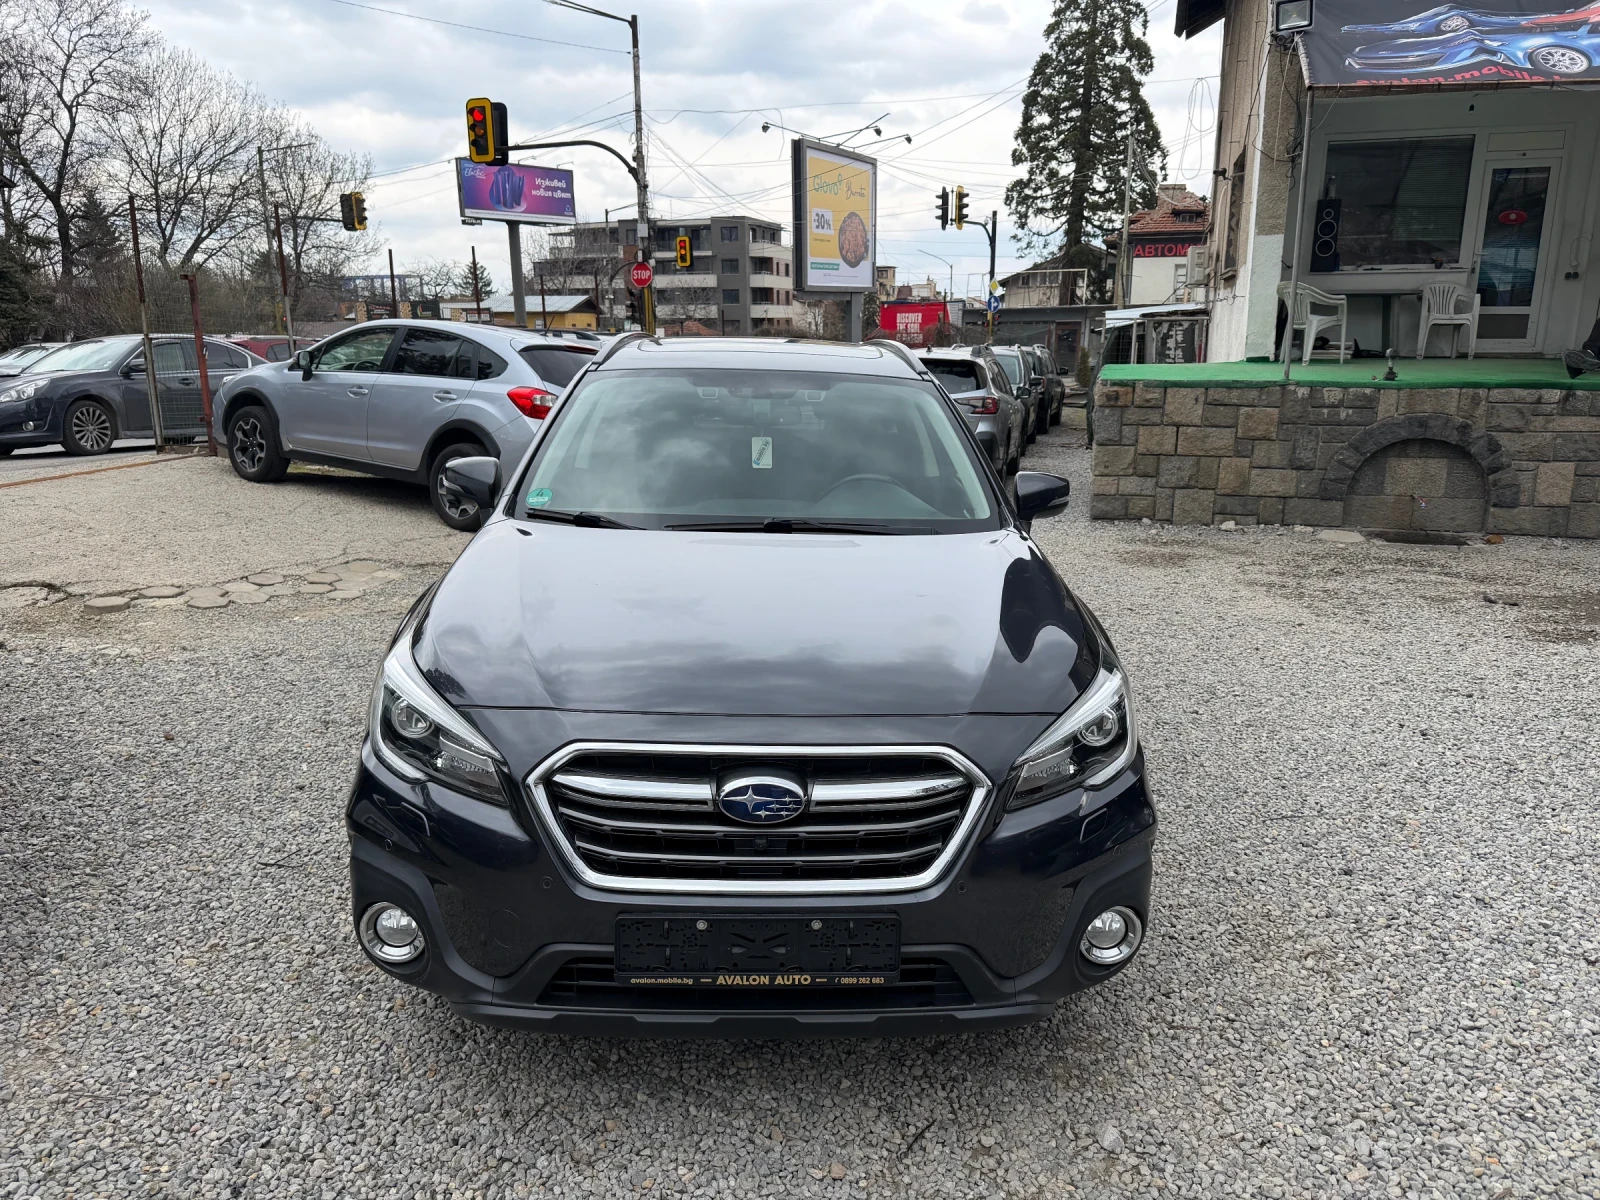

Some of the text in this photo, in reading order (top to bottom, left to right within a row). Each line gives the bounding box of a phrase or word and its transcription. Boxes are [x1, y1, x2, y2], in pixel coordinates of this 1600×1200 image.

[535, 177, 566, 189] Изживей
[813, 174, 840, 196] Glovo
[531, 189, 571, 199] новия цвят
[813, 212, 832, 230] -30%
[1133, 243, 1194, 257] АВТОМ
[633, 270, 651, 280] STOP
[896, 312, 922, 323] DISCOVER
[630, 975, 885, 985] avalon.mobile.bg AVALON AUTO 0899 262 683
